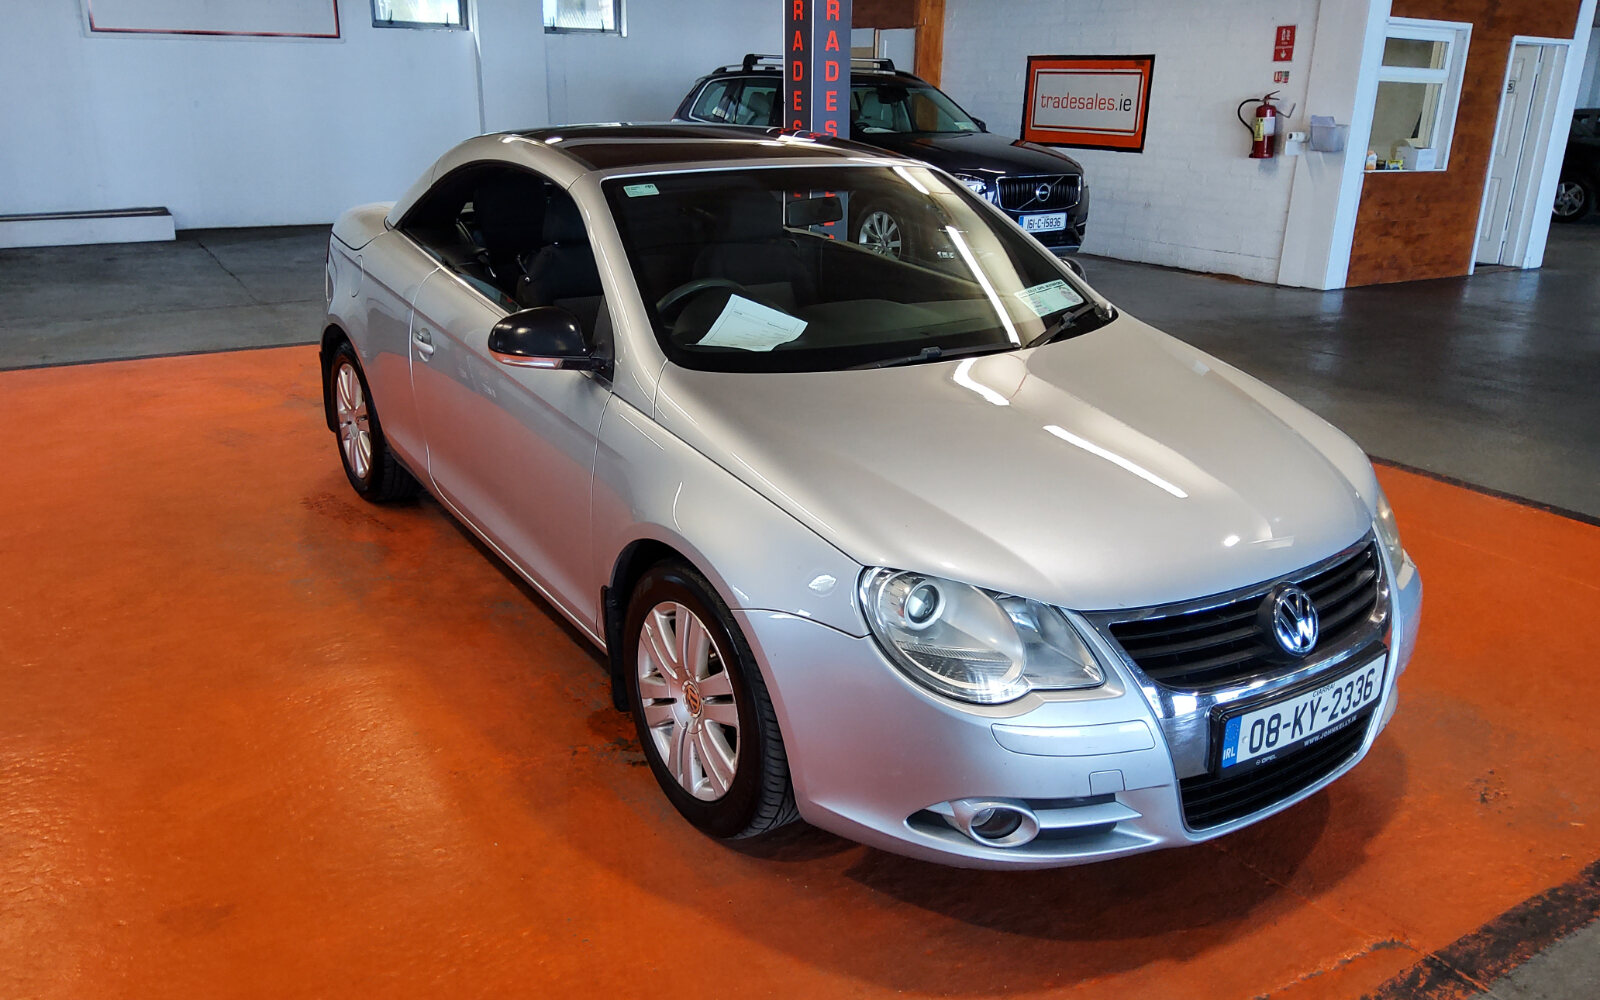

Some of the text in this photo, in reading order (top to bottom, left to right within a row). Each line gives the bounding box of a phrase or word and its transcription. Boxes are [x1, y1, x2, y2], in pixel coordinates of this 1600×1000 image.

[1041, 92, 1132, 112] tradesales.ie
[1027, 217, 1061, 229] 161-C-15836
[1249, 668, 1375, 754] 08-KY-2336
[1223, 746, 1236, 760] IRL
[1262, 754, 1277, 763] OPEL
